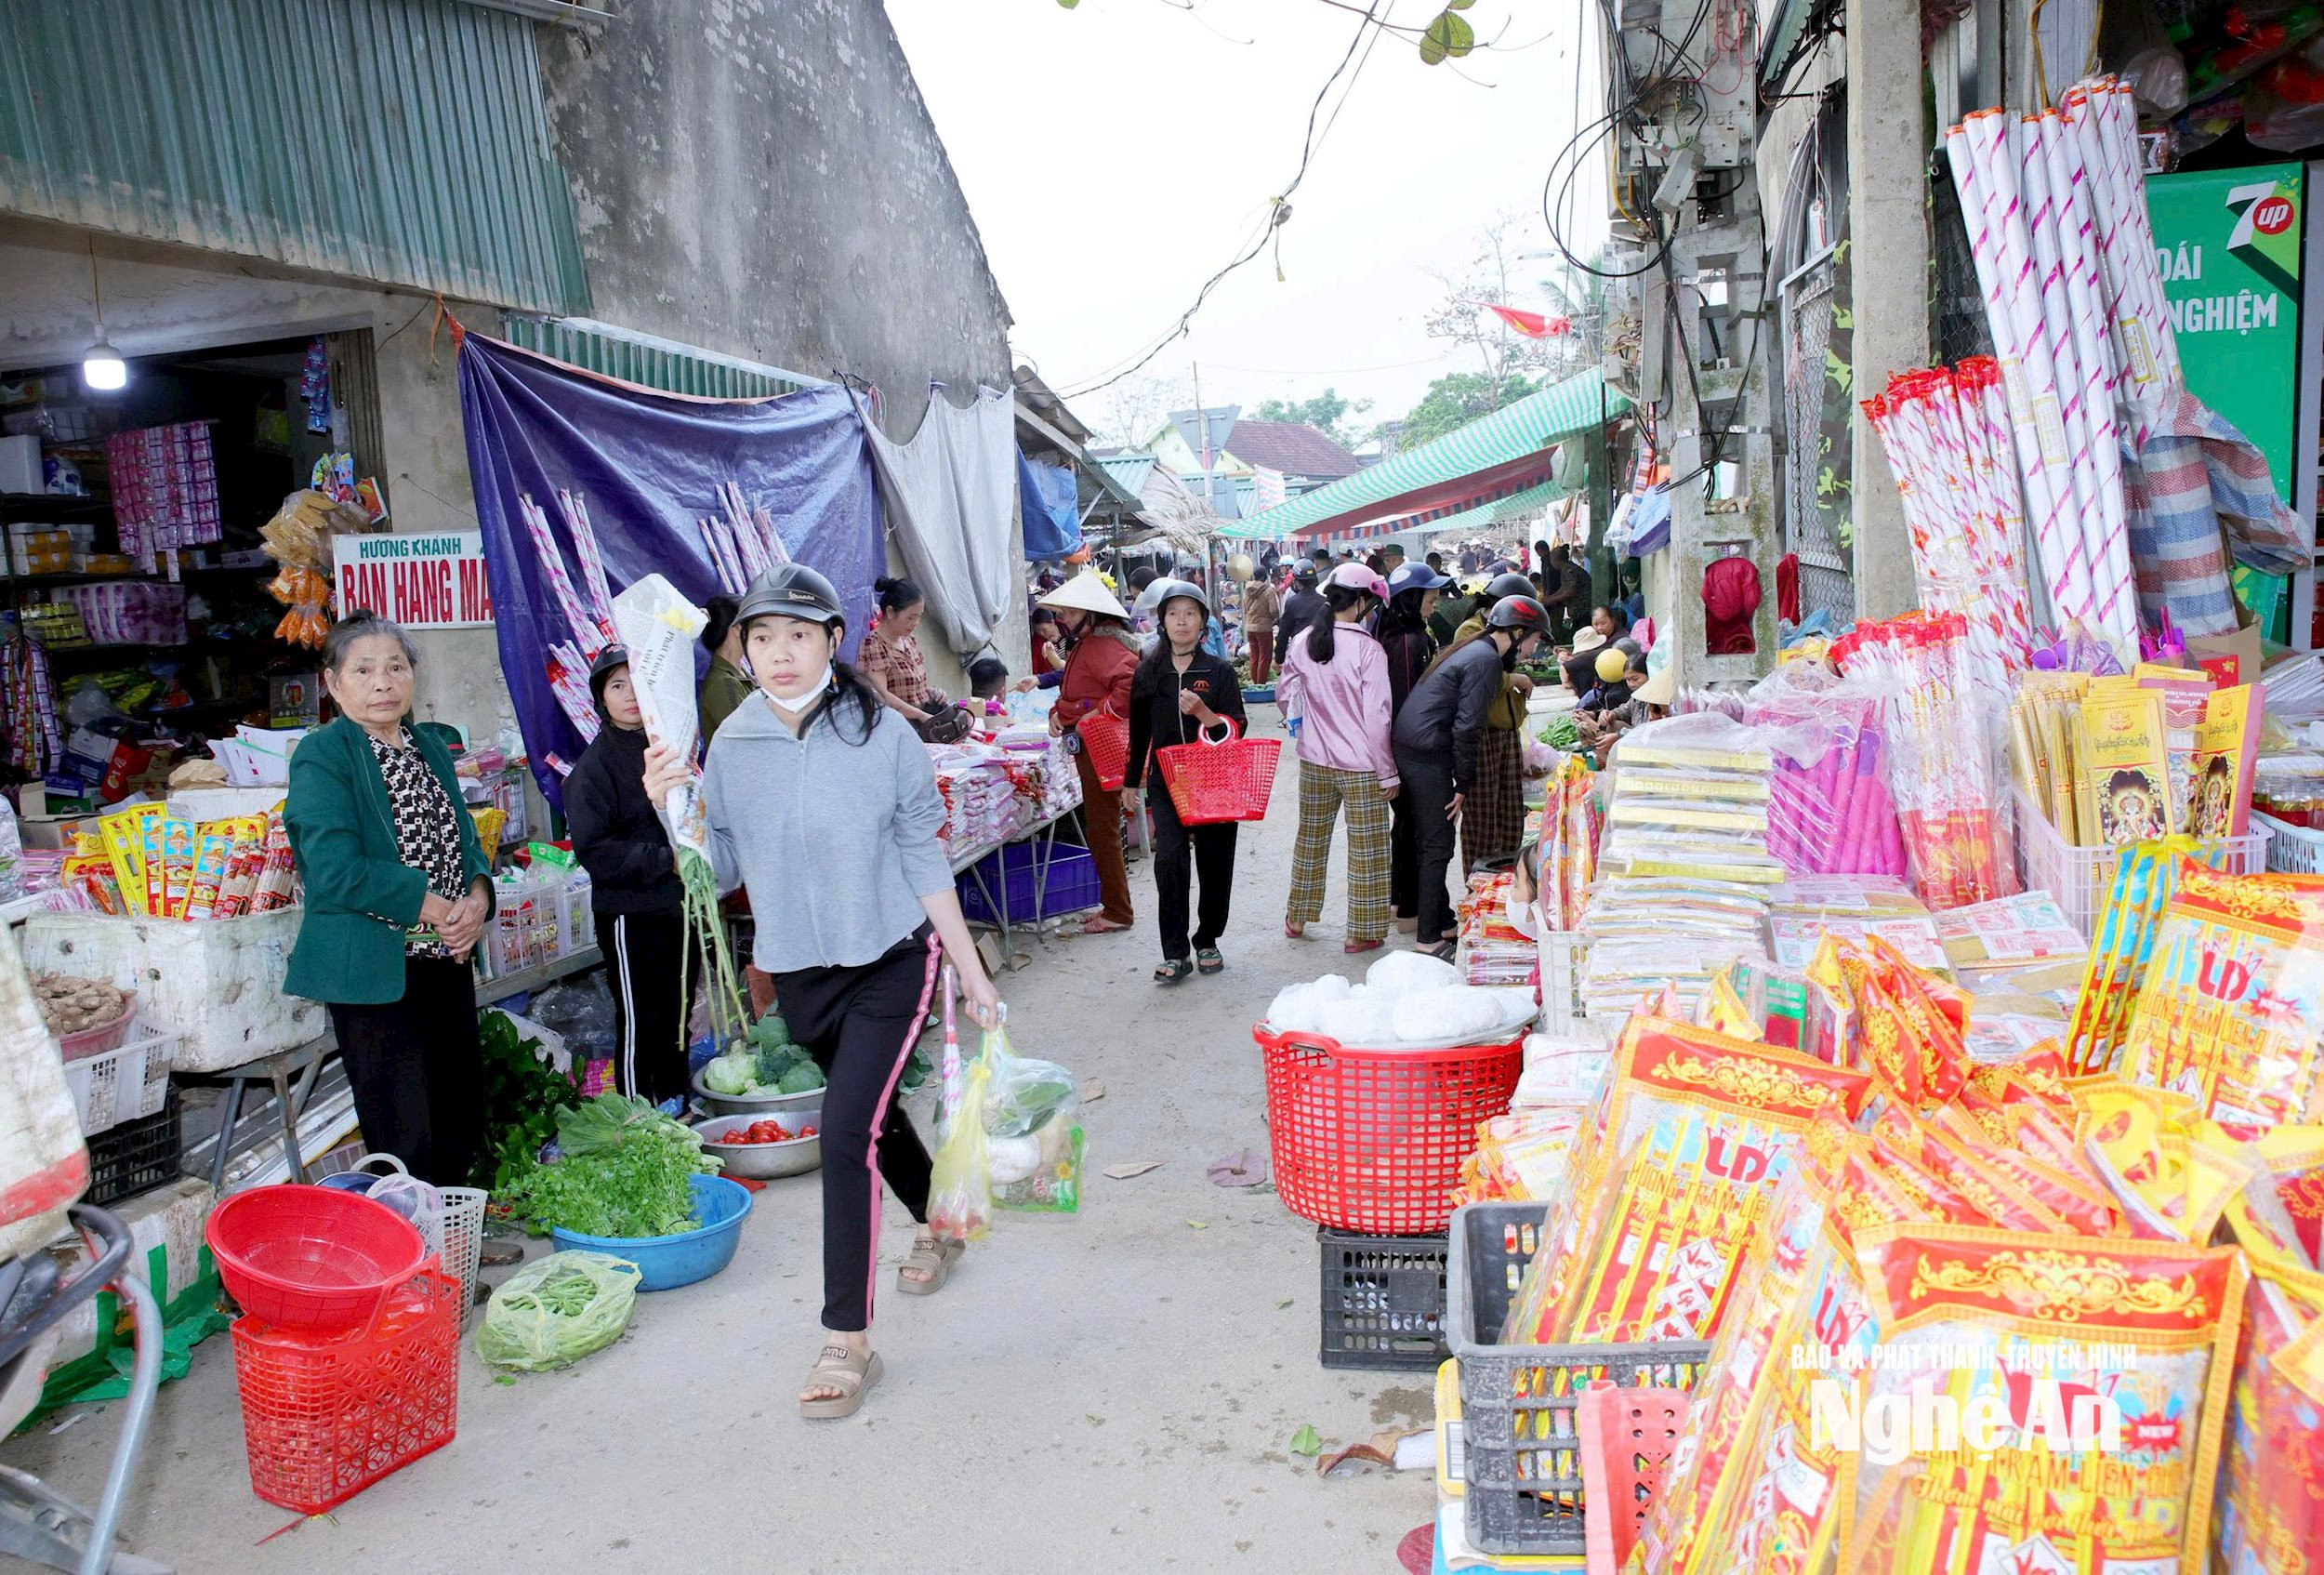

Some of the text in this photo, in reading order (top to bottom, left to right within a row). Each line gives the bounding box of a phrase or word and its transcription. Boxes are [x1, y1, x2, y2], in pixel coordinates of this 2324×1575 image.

[2166, 289, 2278, 336] NGHIỆM
[360, 536, 462, 558] HƯƠNG KHÁNH
